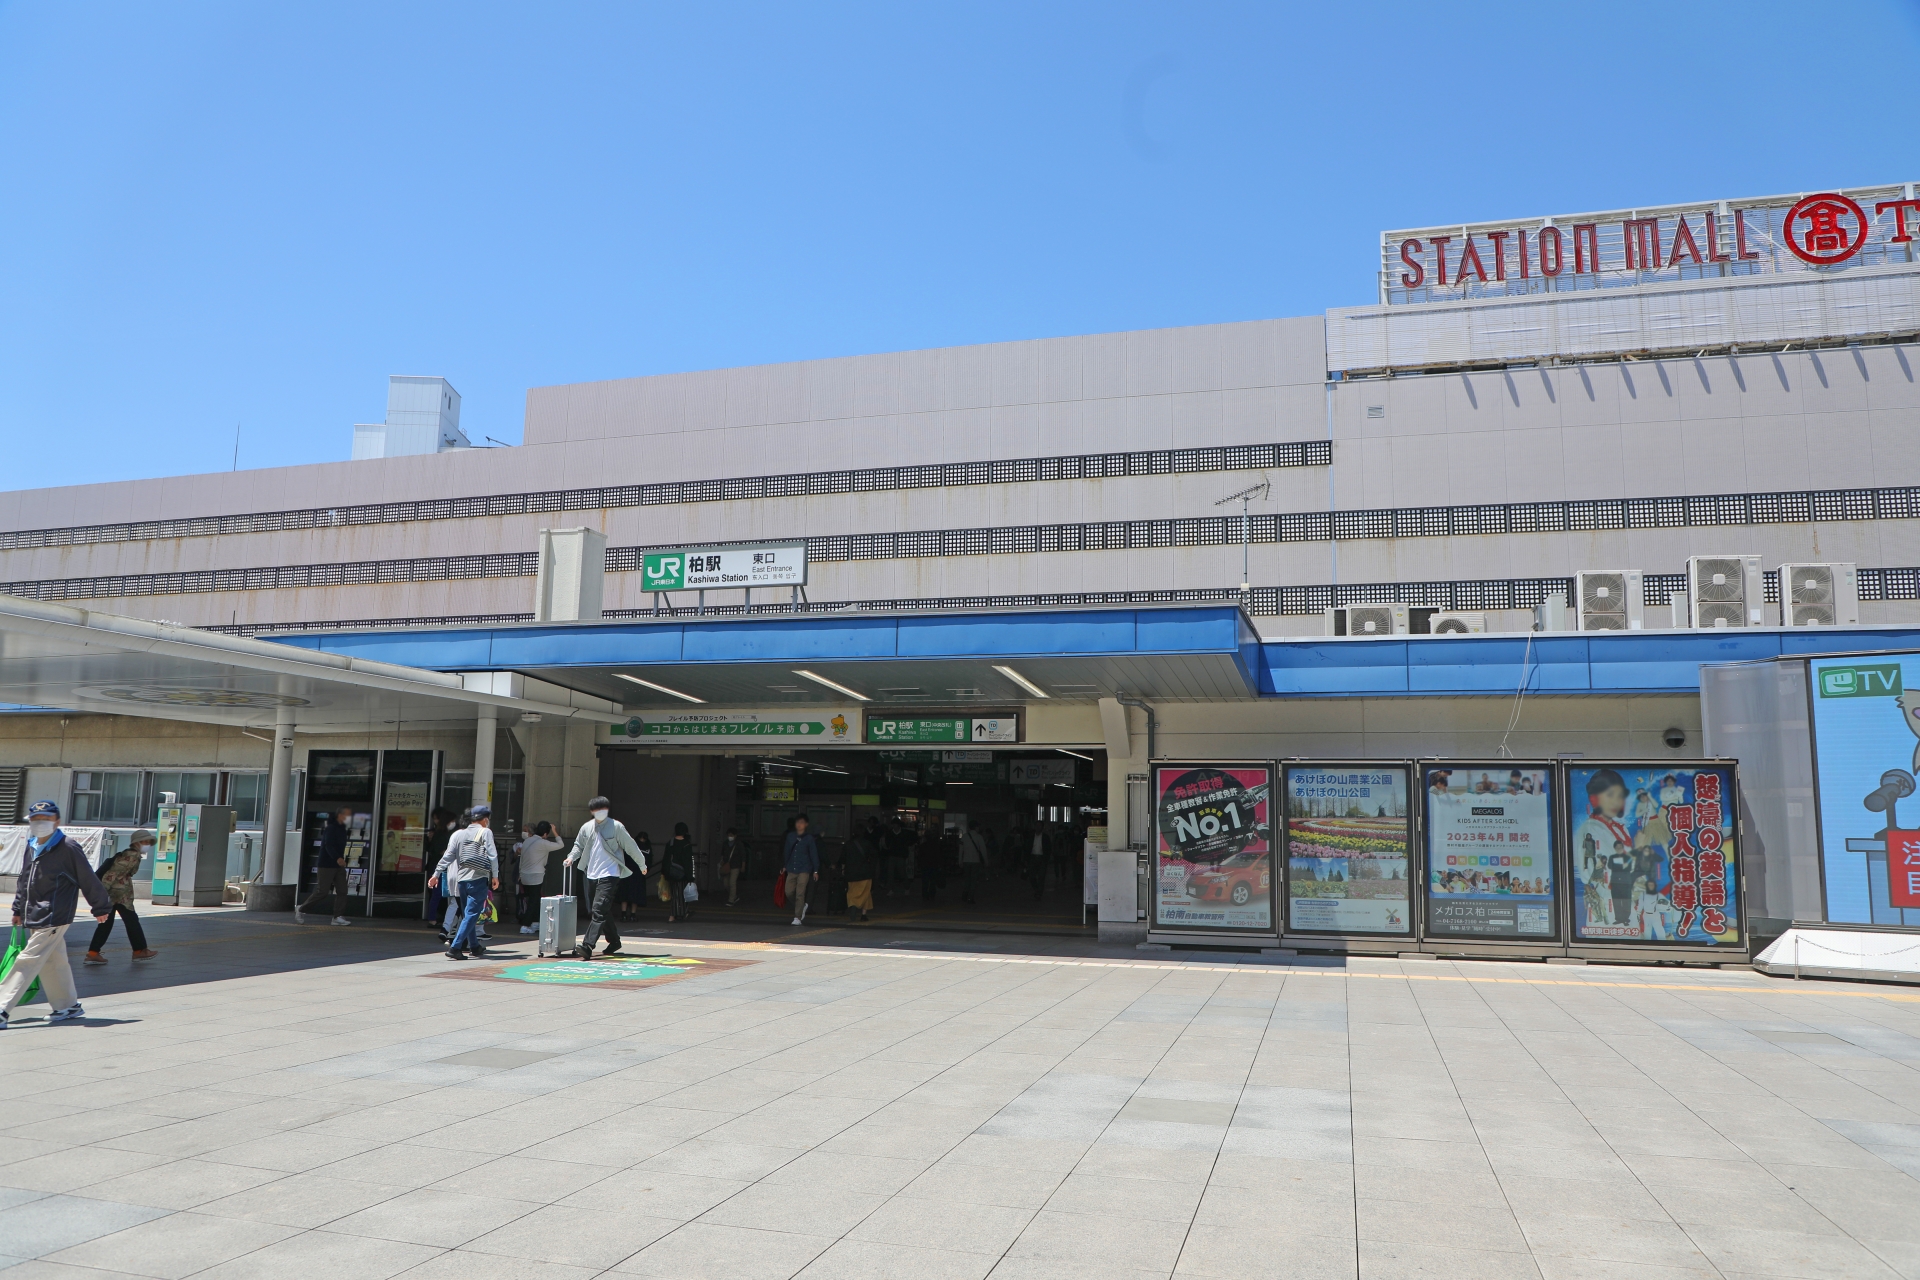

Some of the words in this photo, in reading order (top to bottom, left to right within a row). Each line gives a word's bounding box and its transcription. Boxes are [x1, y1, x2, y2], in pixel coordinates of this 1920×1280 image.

[1875, 199, 1920, 244] T
[1401, 223, 1598, 289] STATION
[1622, 209, 1760, 271] MALL
[688, 555, 722, 573] 柏駅
[752, 553, 776, 565] 東口
[647, 557, 681, 579] JR
[766, 565, 793, 573] Entrance
[687, 575, 720, 584] Kashiwa
[721, 573, 749, 583] Station
[651, 723, 796, 735] ココからはじまるフレイル予防
[873, 721, 897, 735] JR
[898, 721, 914, 730] 柏駅
[1295, 774, 1393, 785] あけぼの山農業公園
[1173, 776, 1224, 800] 免許取得
[1295, 787, 1371, 798] あけぼの山公園
[387, 799, 411, 808] Google
[411, 799, 425, 807] Pay
[1173, 802, 1242, 843] No.1
[1446, 832, 1505, 842] 2023年4月
[1509, 832, 1530, 843] 開校
[1165, 910, 1225, 921] 柏南自動車教習所
[1435, 906, 1486, 916] メガロス柏
[1581, 926, 1640, 936] 柏駅東口徒歩4分
